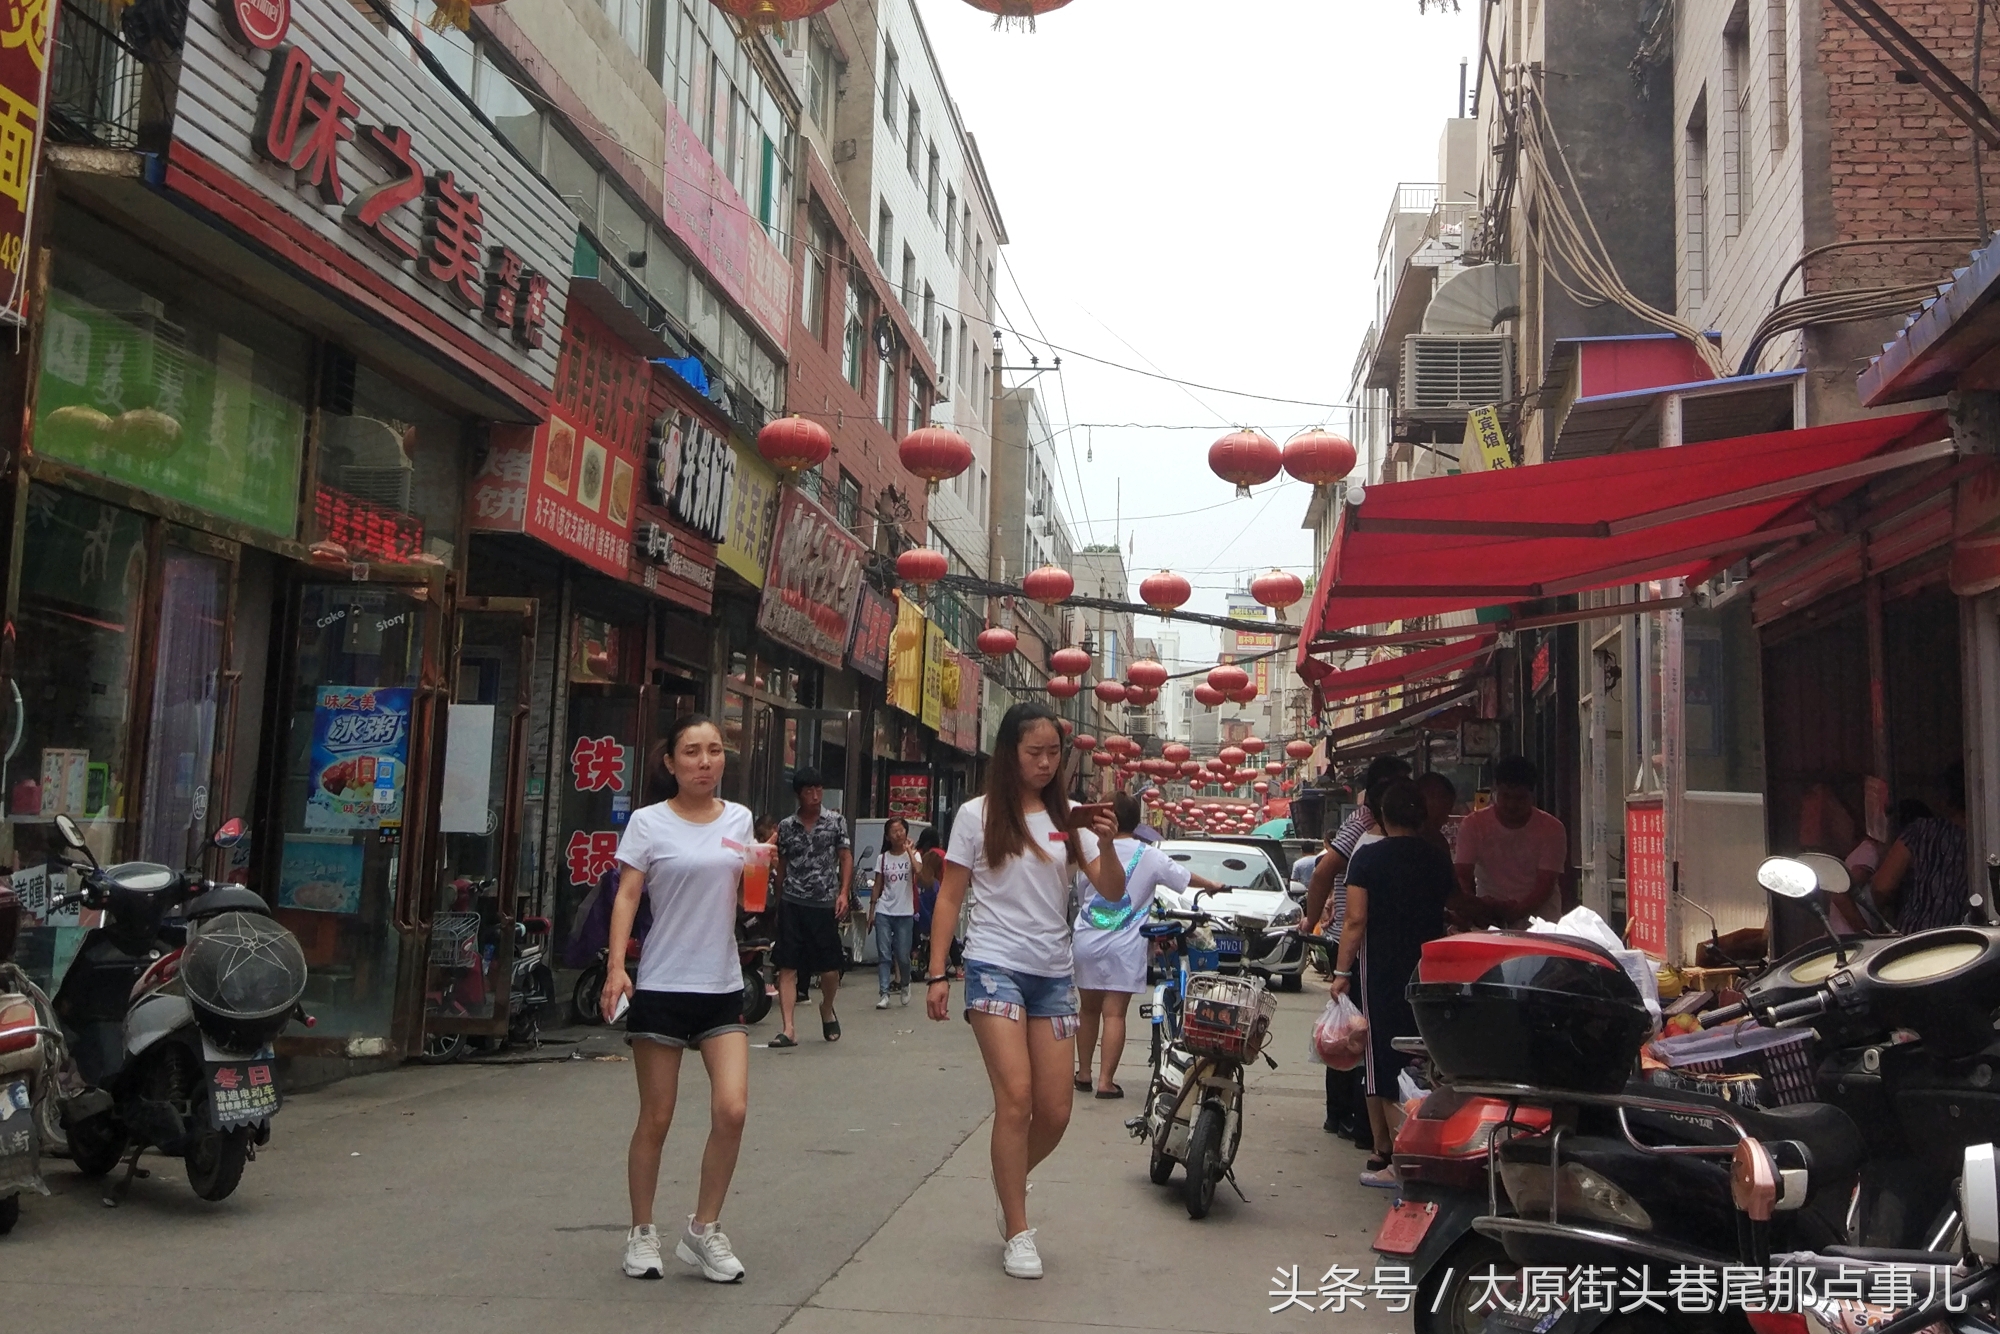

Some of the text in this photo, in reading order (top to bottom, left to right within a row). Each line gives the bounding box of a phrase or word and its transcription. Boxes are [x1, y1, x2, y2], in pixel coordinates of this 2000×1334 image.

[258, 46, 485, 311] 味之美
[316, 609, 406, 632] Cake Story
[324, 693, 377, 712] 味之美
[329, 714, 399, 744] 冰粥
[215, 1085, 275, 1102] 雅迪电动车
